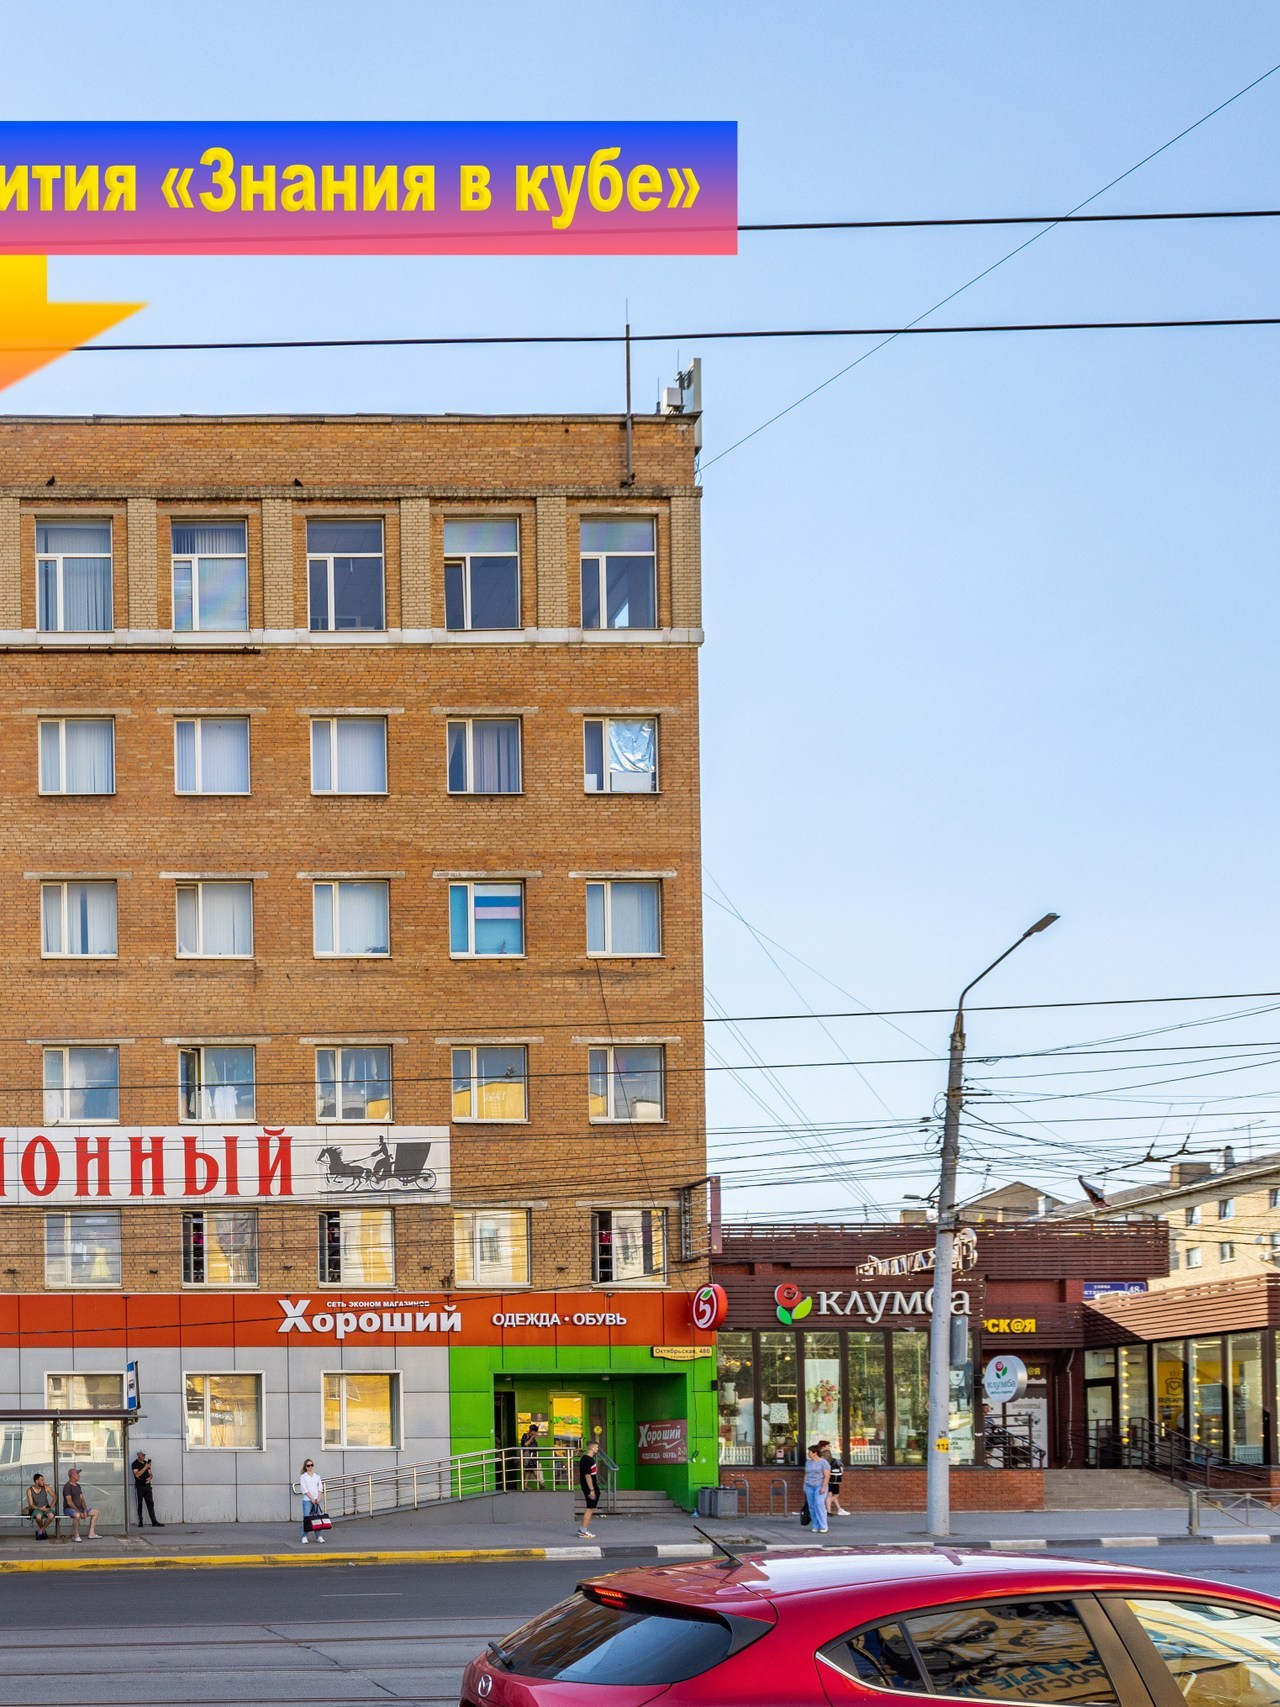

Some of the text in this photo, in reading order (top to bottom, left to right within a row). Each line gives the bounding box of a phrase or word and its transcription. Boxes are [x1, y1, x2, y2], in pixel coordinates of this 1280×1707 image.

[277, 1299, 462, 1339] Хороший
[491, 1312, 627, 1328] ОДЕЖДА ОБУВЬ
[638, 1424, 682, 1448] Хороший
